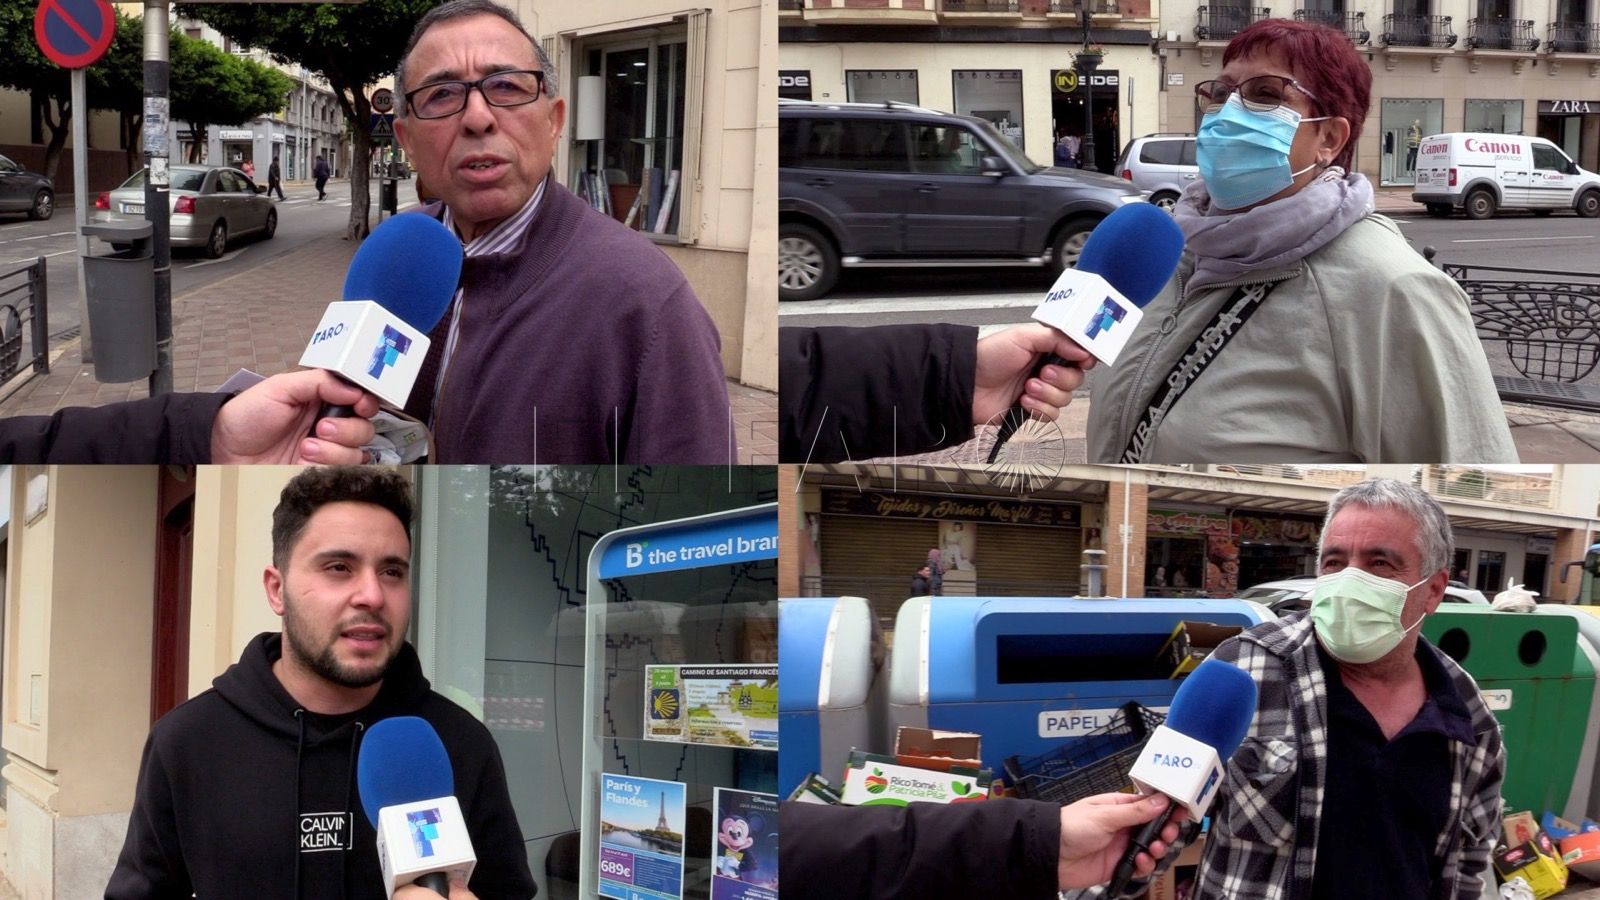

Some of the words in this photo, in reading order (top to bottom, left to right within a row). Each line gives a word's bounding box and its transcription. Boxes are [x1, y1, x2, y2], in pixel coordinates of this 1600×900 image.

[376, 96, 390, 105] 30
[1551, 100, 1591, 113] ZARA
[1421, 143, 1448, 155] Canon
[1464, 138, 1521, 155] Canon
[870, 493, 919, 516] Tejidos
[626, 542, 644, 569] B
[648, 548, 677, 565] the
[680, 538, 733, 561] travel
[681, 668, 706, 676] CAMINO
[706, 668, 715, 676] DE
[716, 668, 748, 676] SANTIAGO
[1046, 715, 1101, 731] PAPEL
[633, 784, 641, 796] y
[889, 784, 926, 798] Patricia
[926, 789, 947, 800] Pilar
[606, 791, 649, 808] Flandes
[301, 816, 345, 832] CALVIN
[600, 860, 632, 878] 689€
